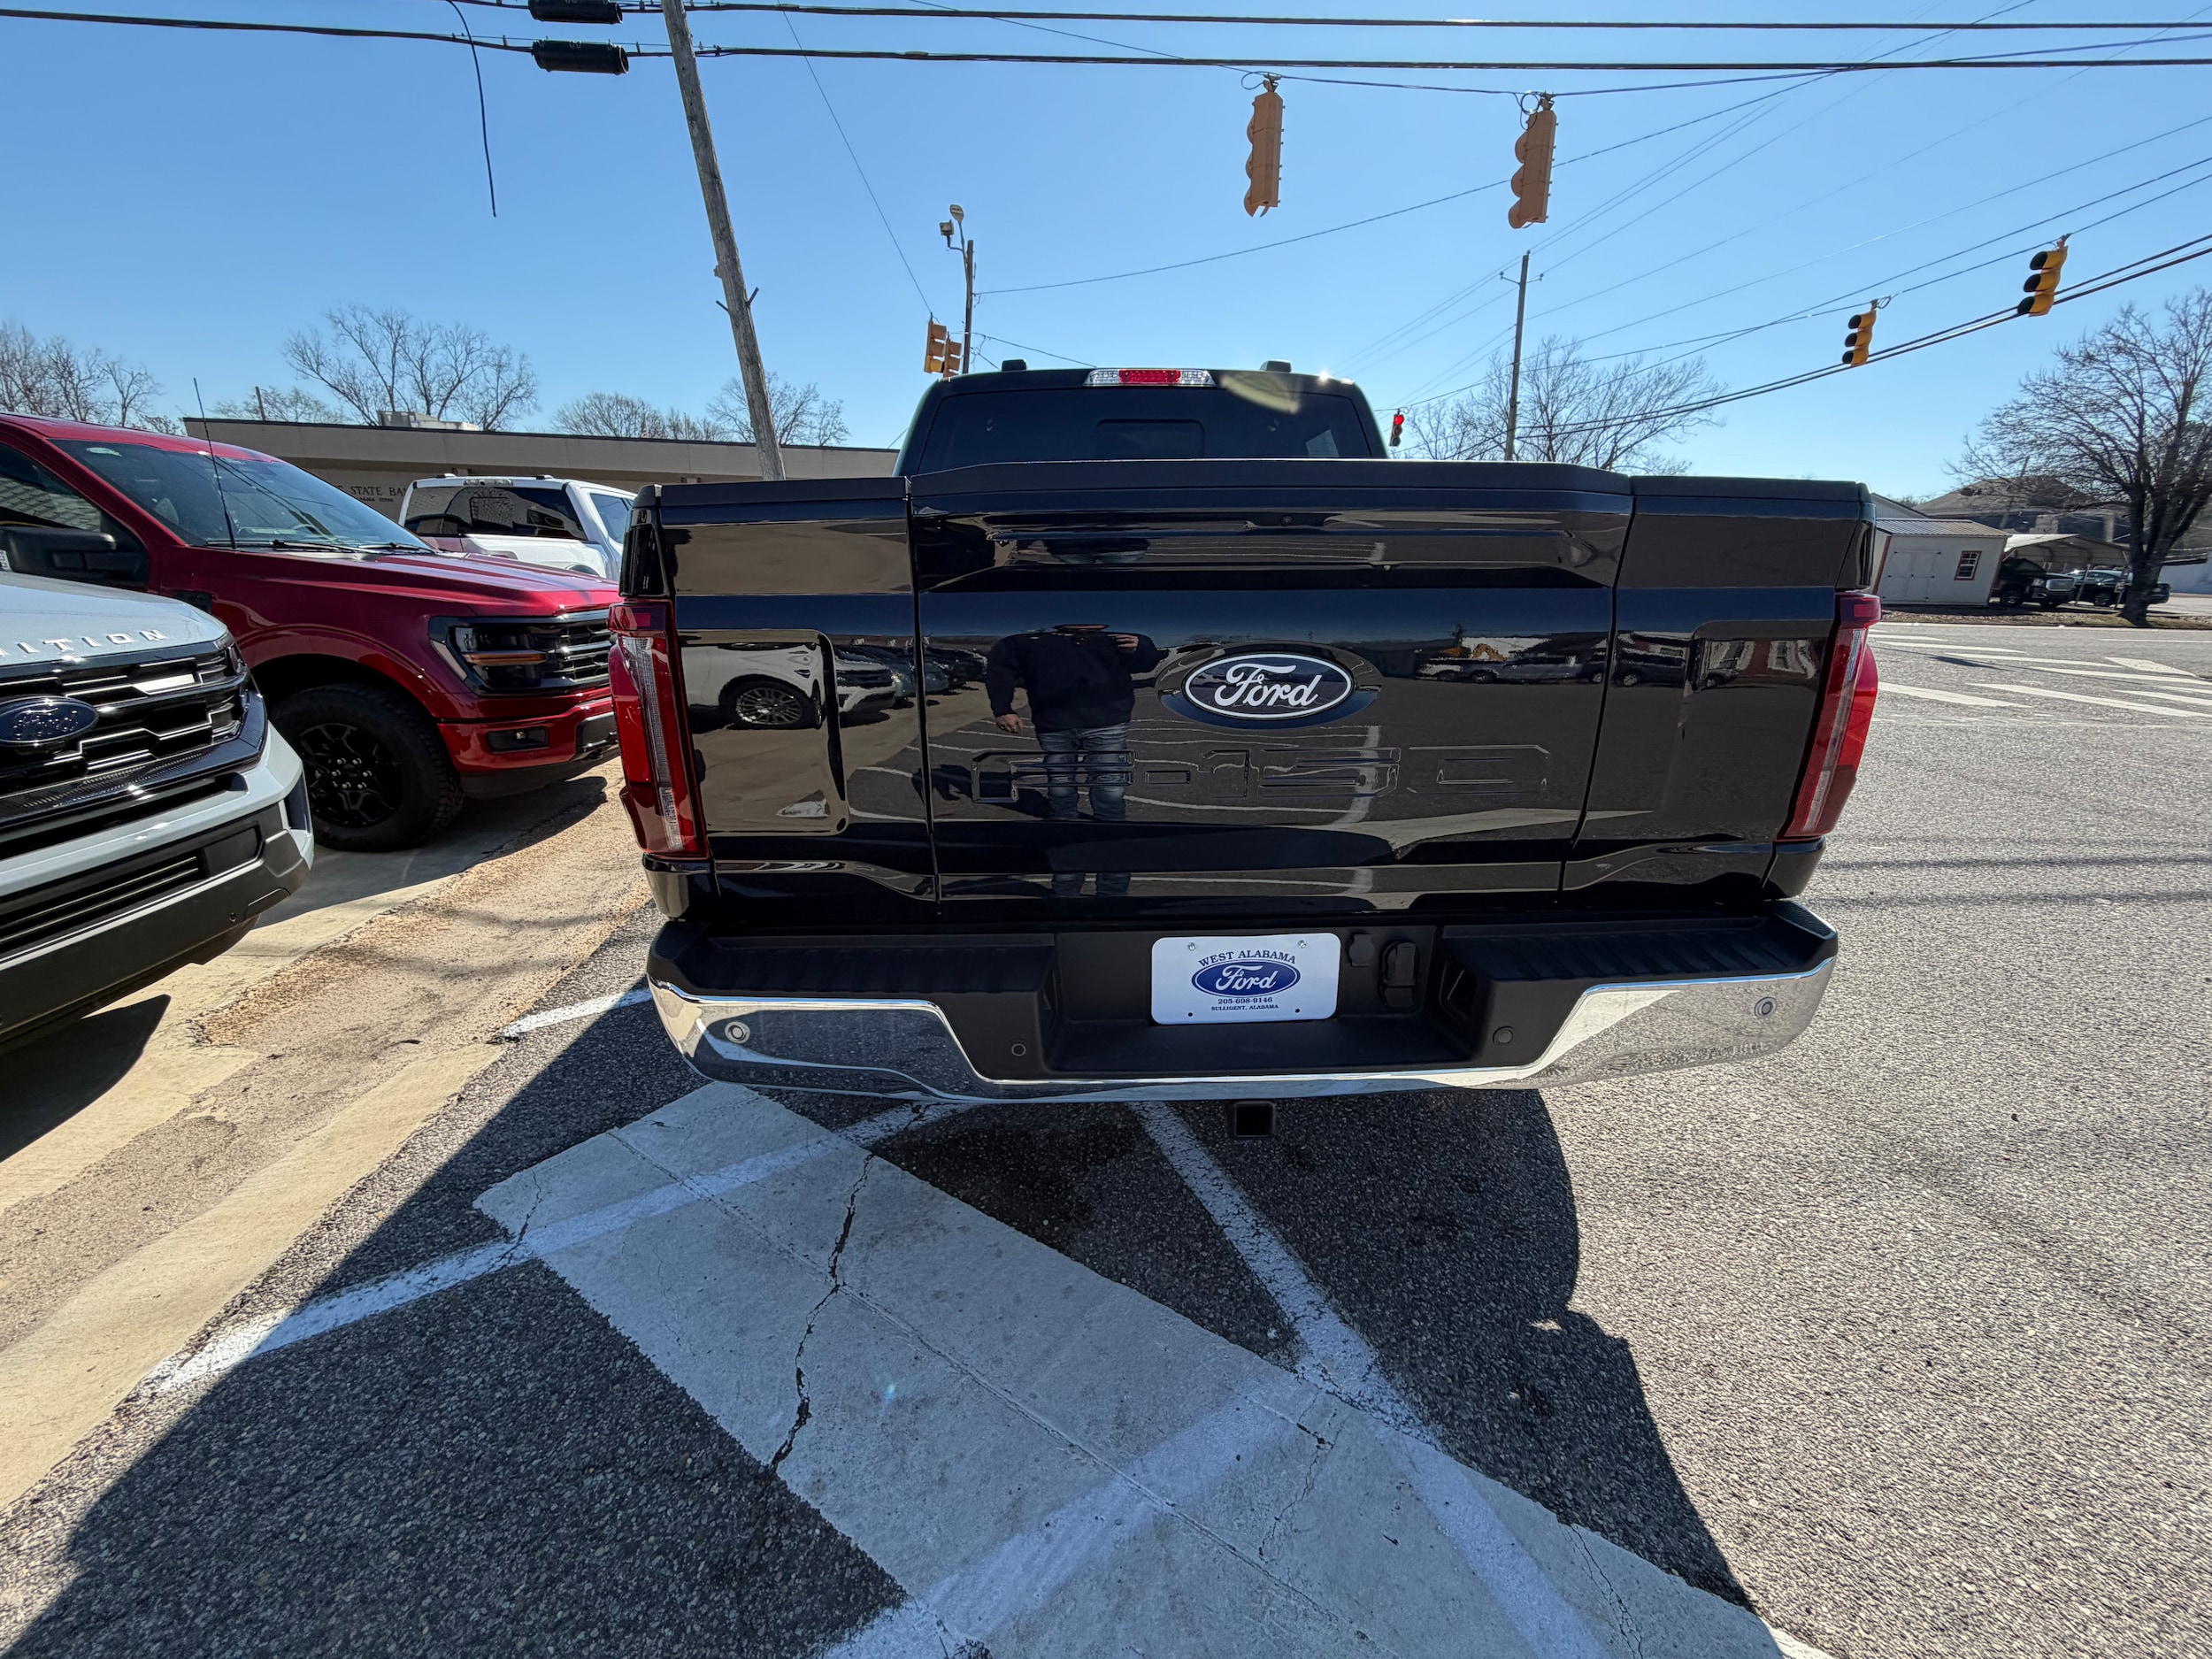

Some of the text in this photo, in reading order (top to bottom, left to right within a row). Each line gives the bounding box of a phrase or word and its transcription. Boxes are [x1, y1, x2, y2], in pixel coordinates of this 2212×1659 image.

[350, 486, 383, 496] STATE
[0, 629, 166, 657] ITION
[1214, 663, 1319, 708] Ford
[1198, 950, 1295, 967] WEST ALABAMA
[1215, 964, 1279, 990] Ford
